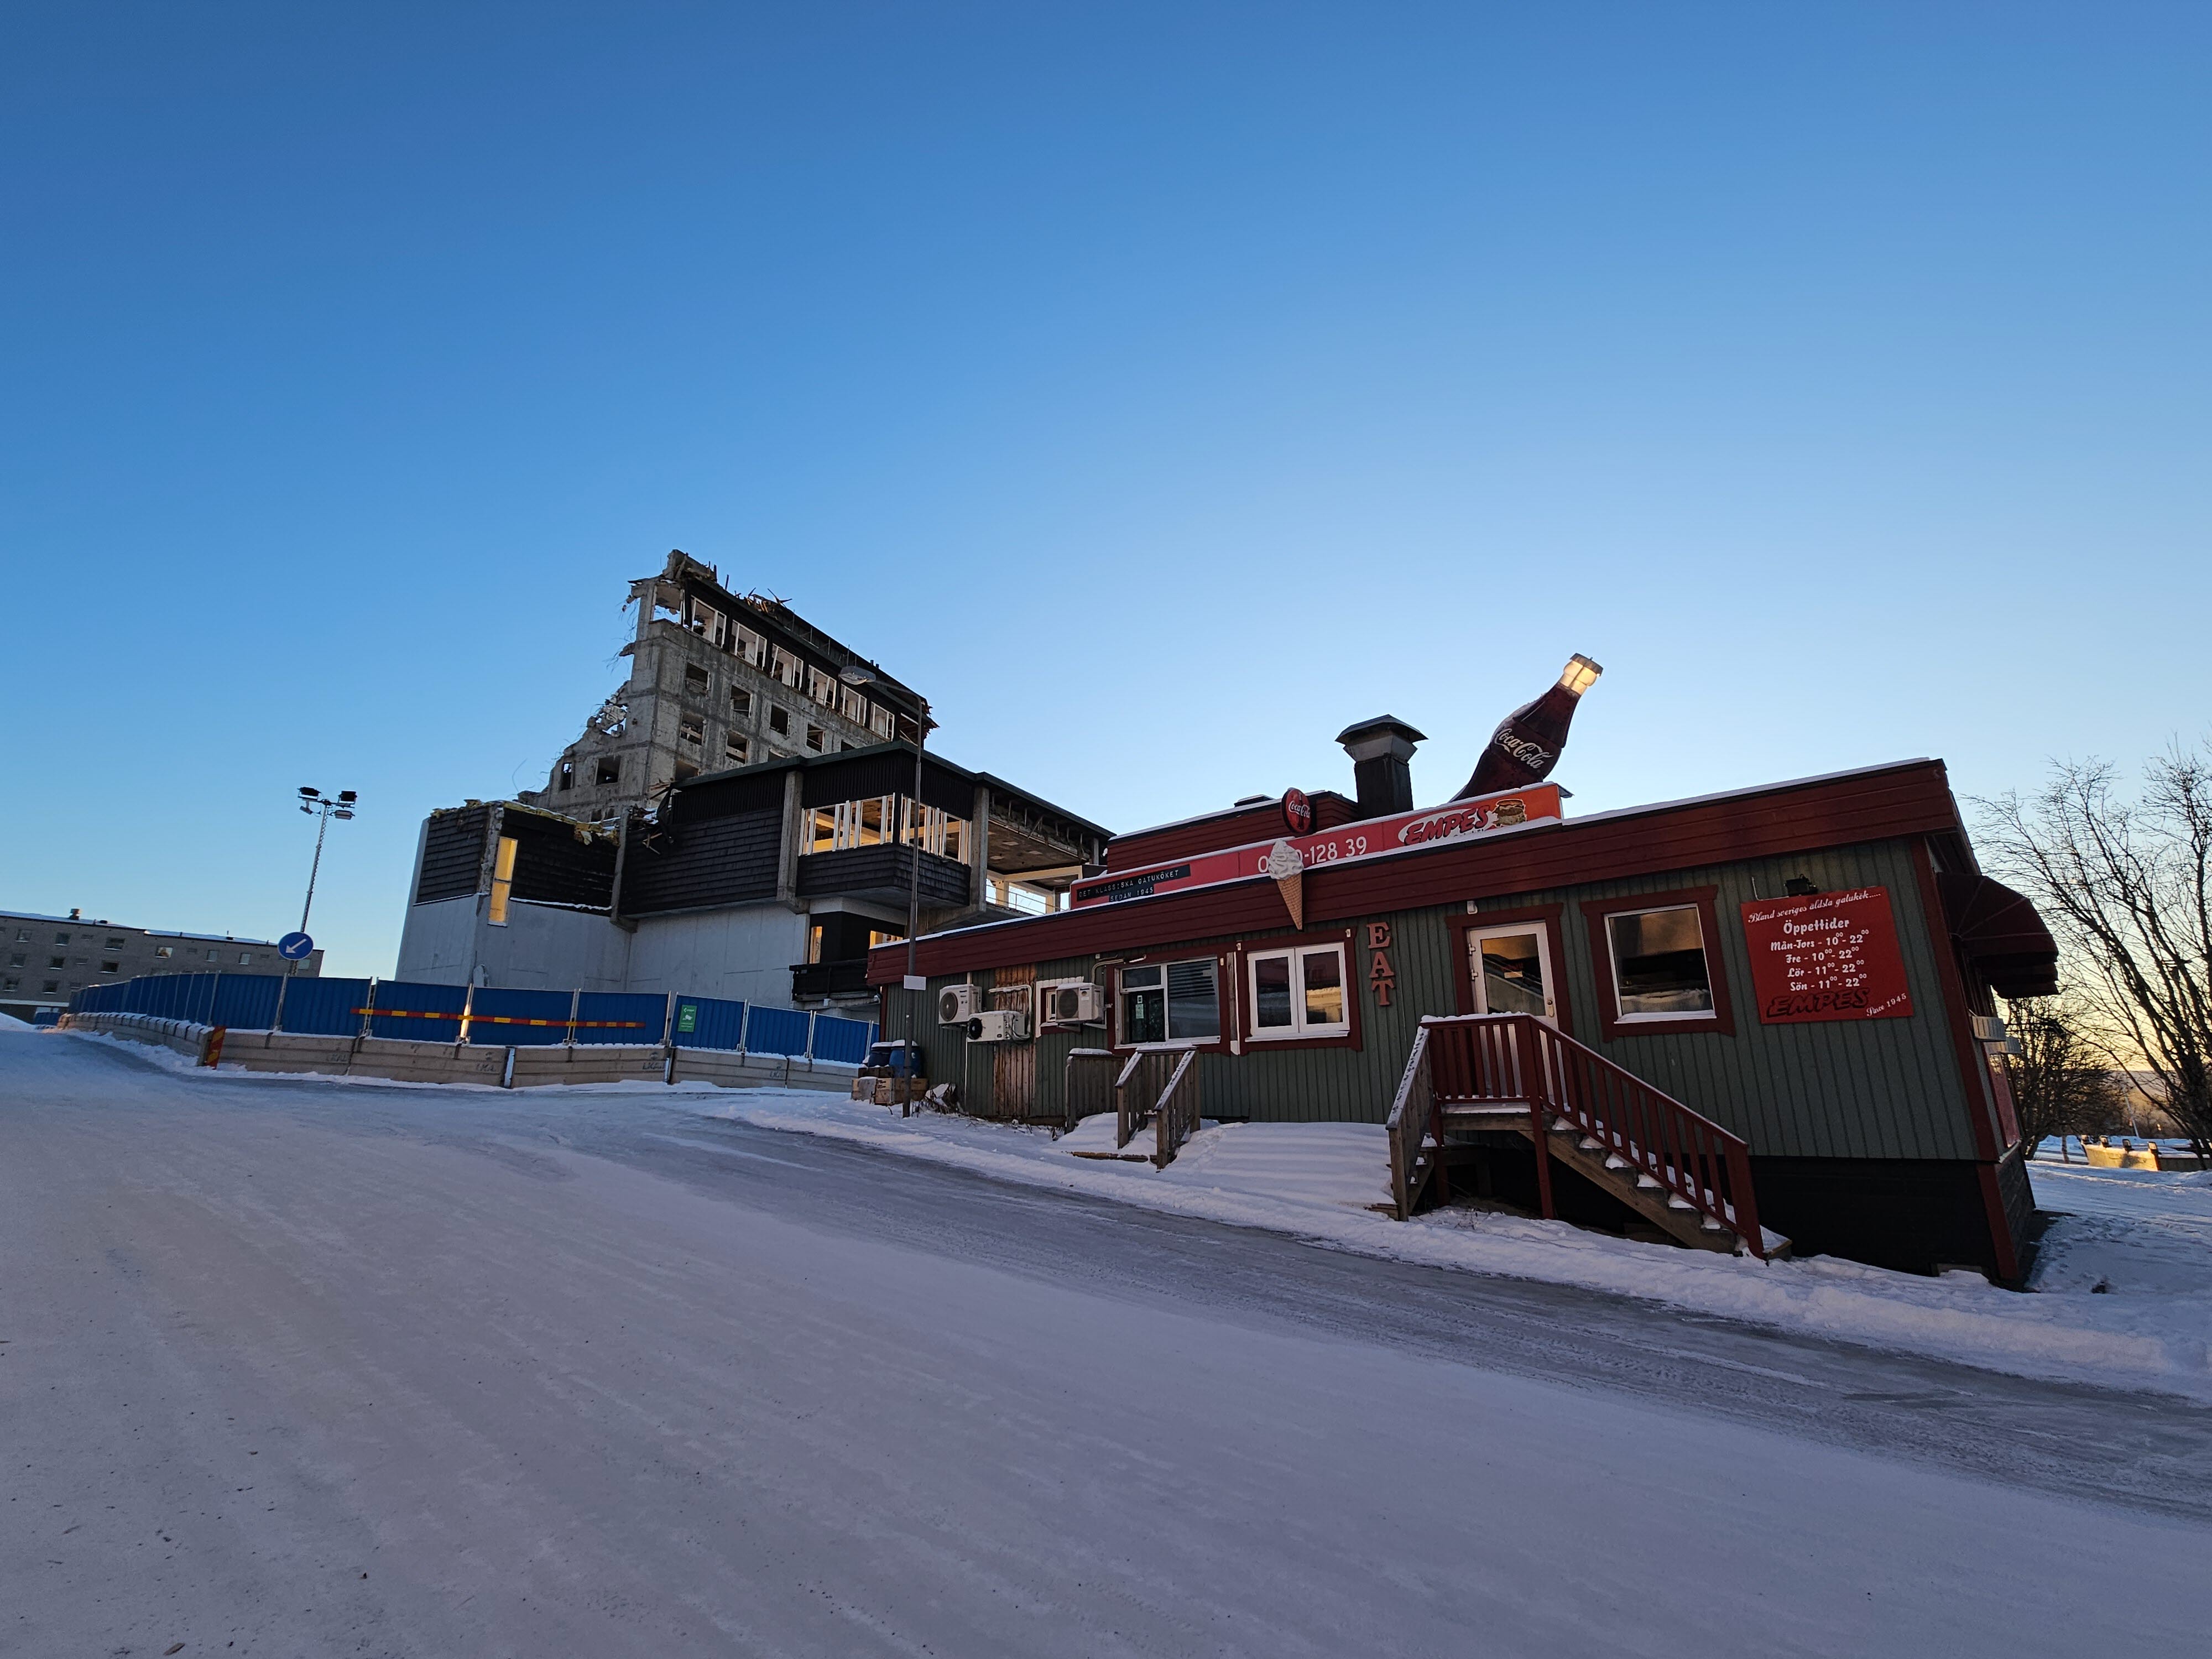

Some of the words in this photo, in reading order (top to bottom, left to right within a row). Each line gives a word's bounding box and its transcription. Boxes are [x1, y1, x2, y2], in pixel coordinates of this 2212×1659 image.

[1494, 728, 1553, 769] Coca-Cola
[1405, 805, 1490, 845] EMPES
[1345, 836, 1367, 857] 39
[1079, 889, 1091, 898] DET
[1095, 881, 1134, 894] KLASSISKA
[1138, 870, 1179, 884] GATUKÖKET
[1110, 892, 1131, 901] SEDAN
[1137, 887, 1154, 896] 1945
[1748, 910, 1775, 923] Bland
[1809, 898, 1833, 910] äldsta
[1783, 917, 1850, 936] Öppettider
[1771, 940, 1815, 951] Mån-Tors
[1366, 922, 1395, 1005] EAT
[1785, 954, 1801, 963] Fre
[1787, 968, 1804, 977] Lör
[1790, 982, 1808, 991] Sön
[1767, 988, 1870, 1018] EMPES
[1866, 1004, 1885, 1016] Since
[1887, 993, 1907, 1007] 1945
